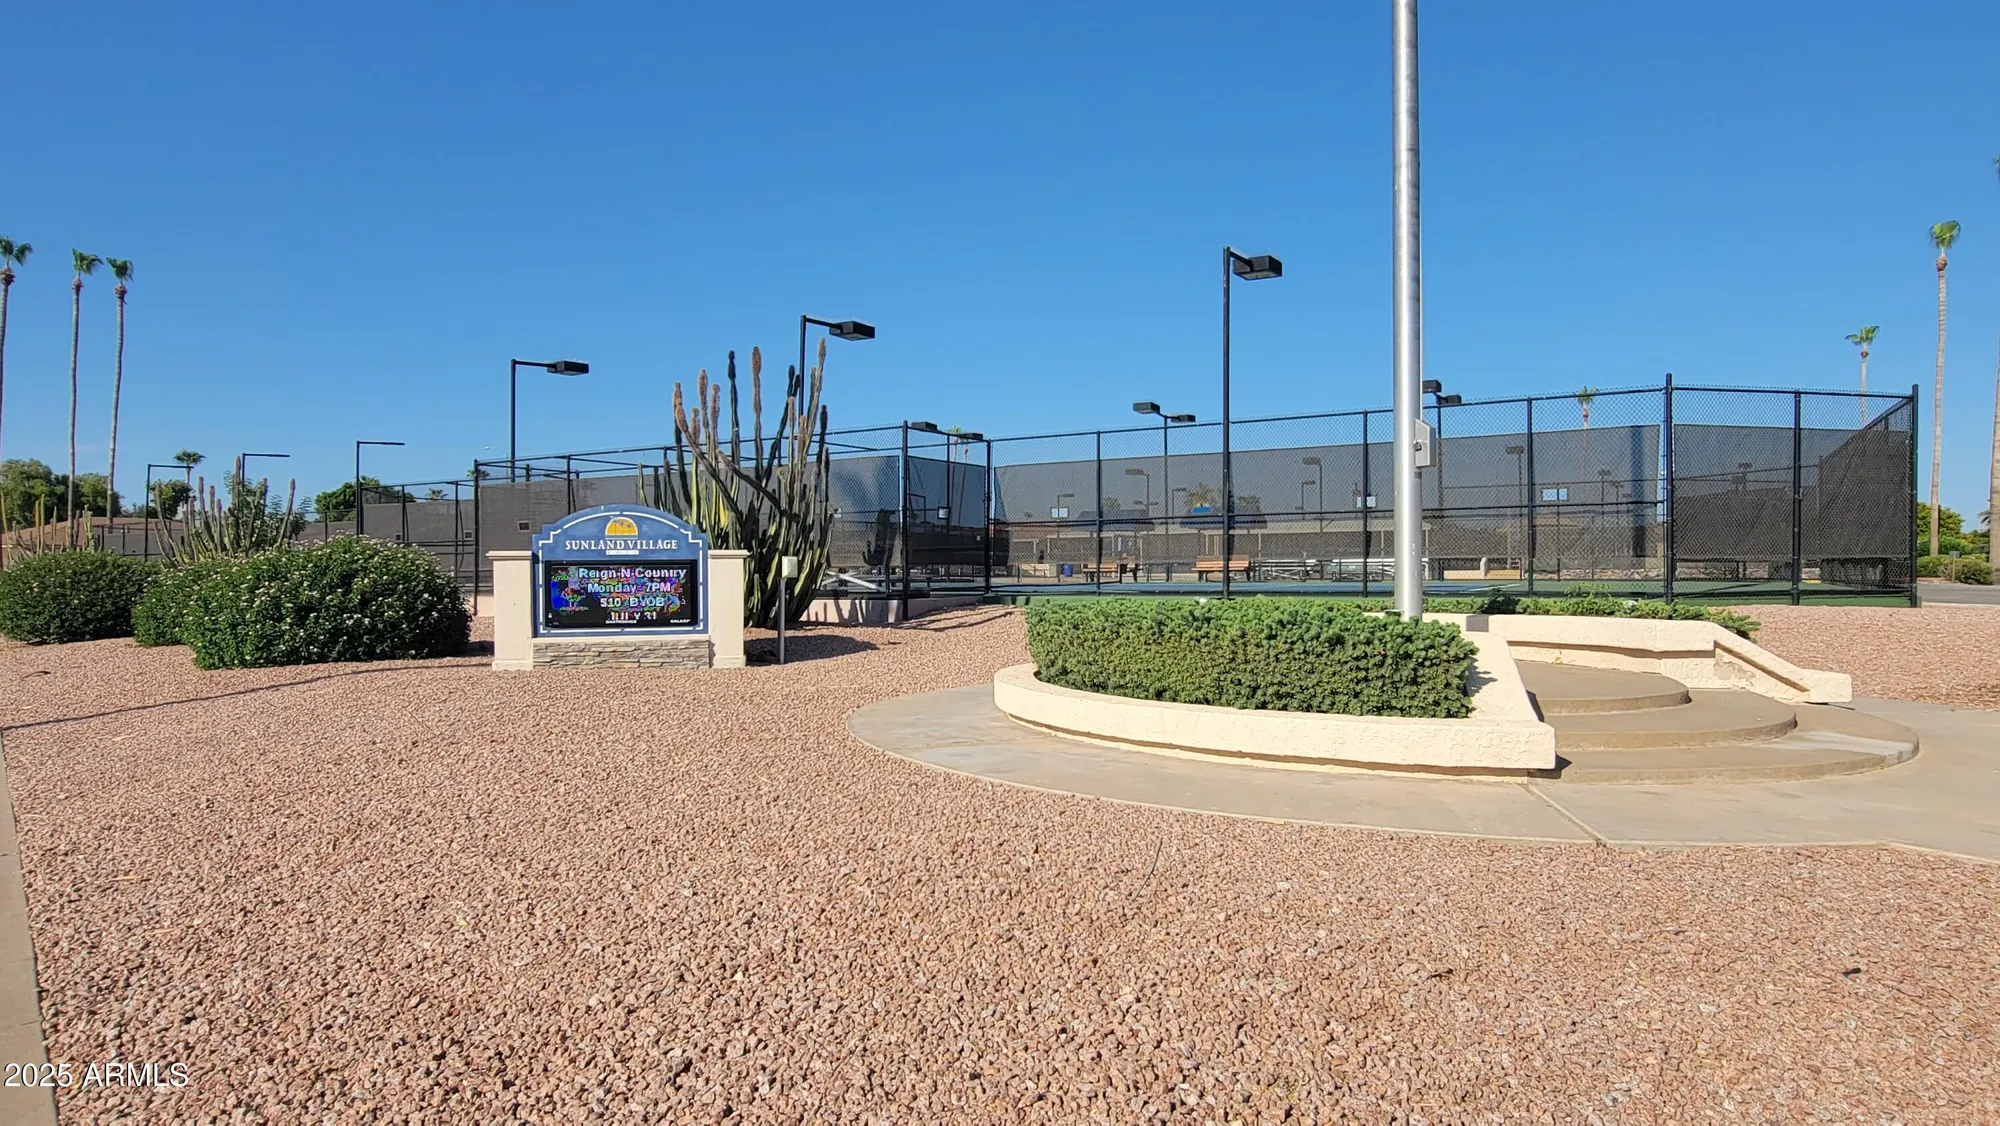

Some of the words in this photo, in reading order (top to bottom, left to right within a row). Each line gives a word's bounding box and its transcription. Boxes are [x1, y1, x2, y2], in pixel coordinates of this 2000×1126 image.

[565, 540, 625, 550] SUNLAND
[627, 539, 678, 550] VILLAGE
[645, 582, 671, 592] 7PM
[629, 597, 665, 607] BYOB
